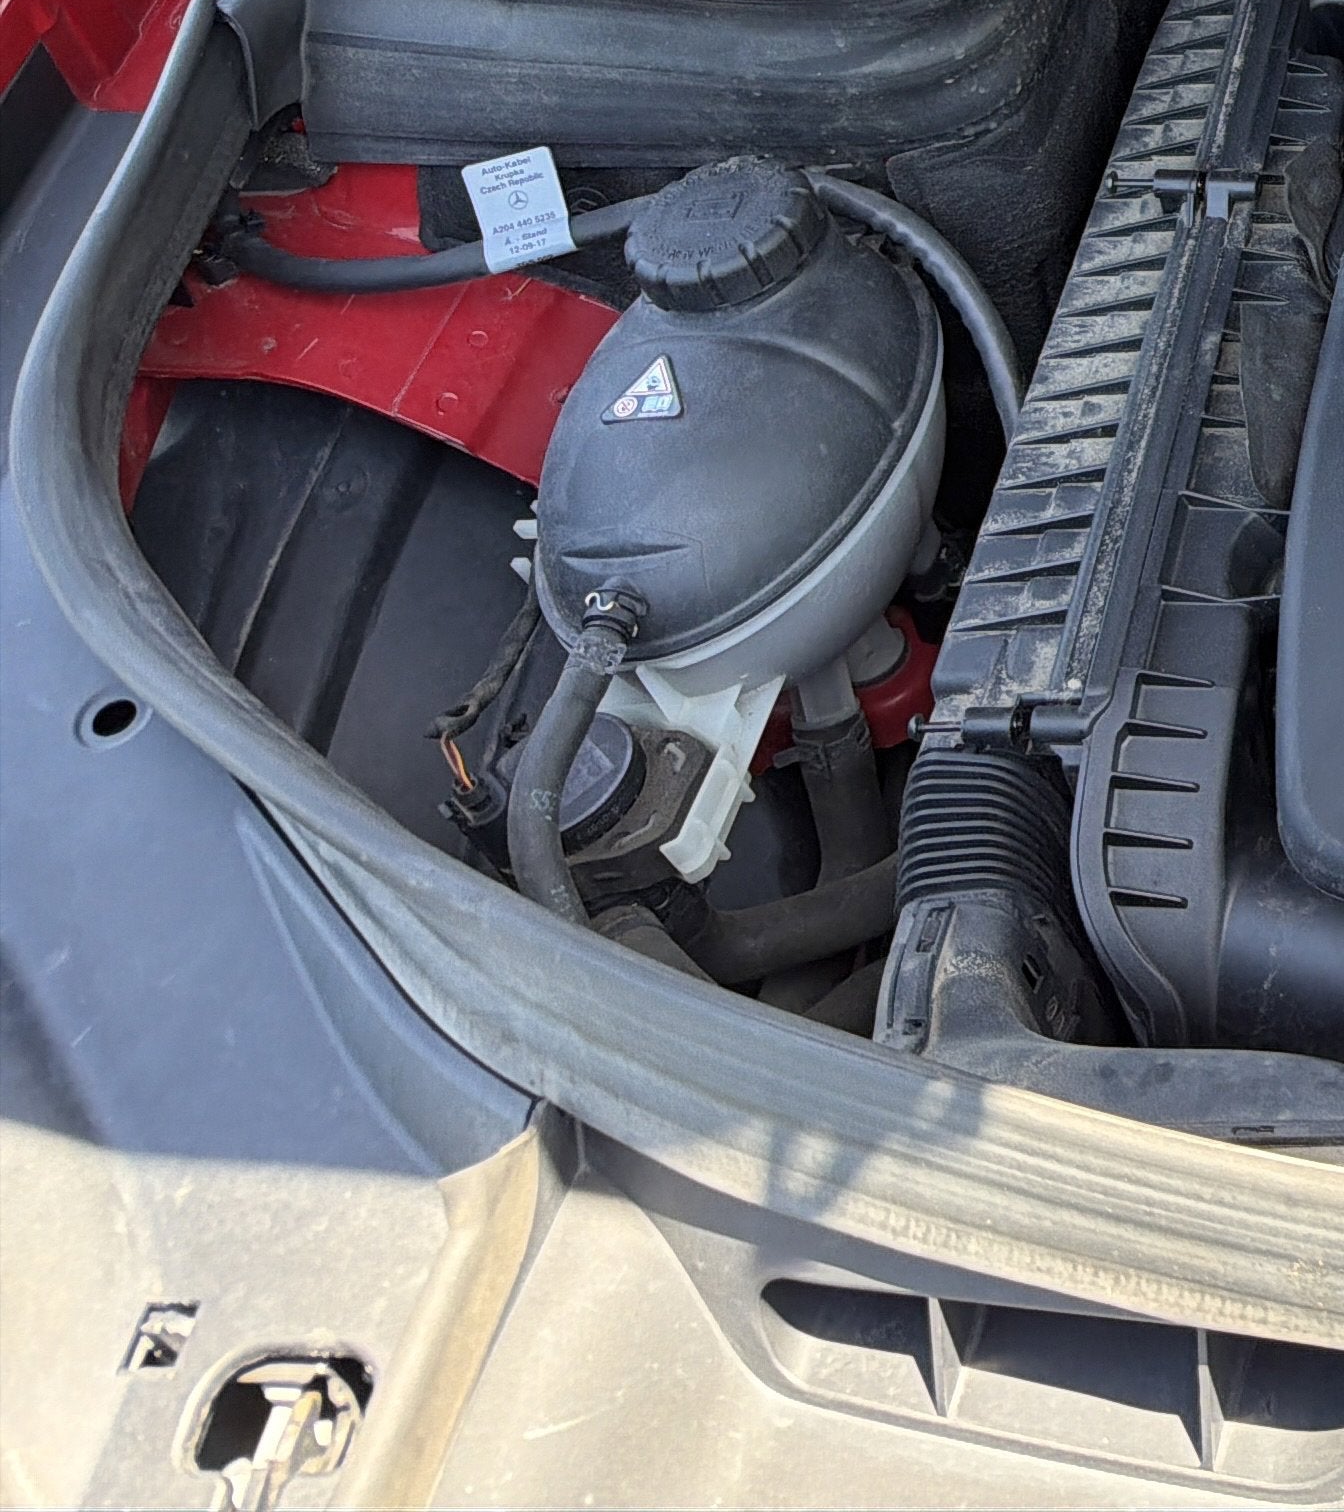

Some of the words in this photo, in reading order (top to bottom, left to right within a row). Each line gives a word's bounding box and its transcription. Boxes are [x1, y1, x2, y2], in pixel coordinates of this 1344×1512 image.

[482, 156, 532, 176] Auto-Kabel
[495, 169, 525, 181] Krupka
[480, 181, 507, 195] Czech
[508, 172, 544, 187] Republic
[493, 223, 515, 235] A204
[517, 217, 533, 228] 440
[535, 211, 556, 223] 5235
